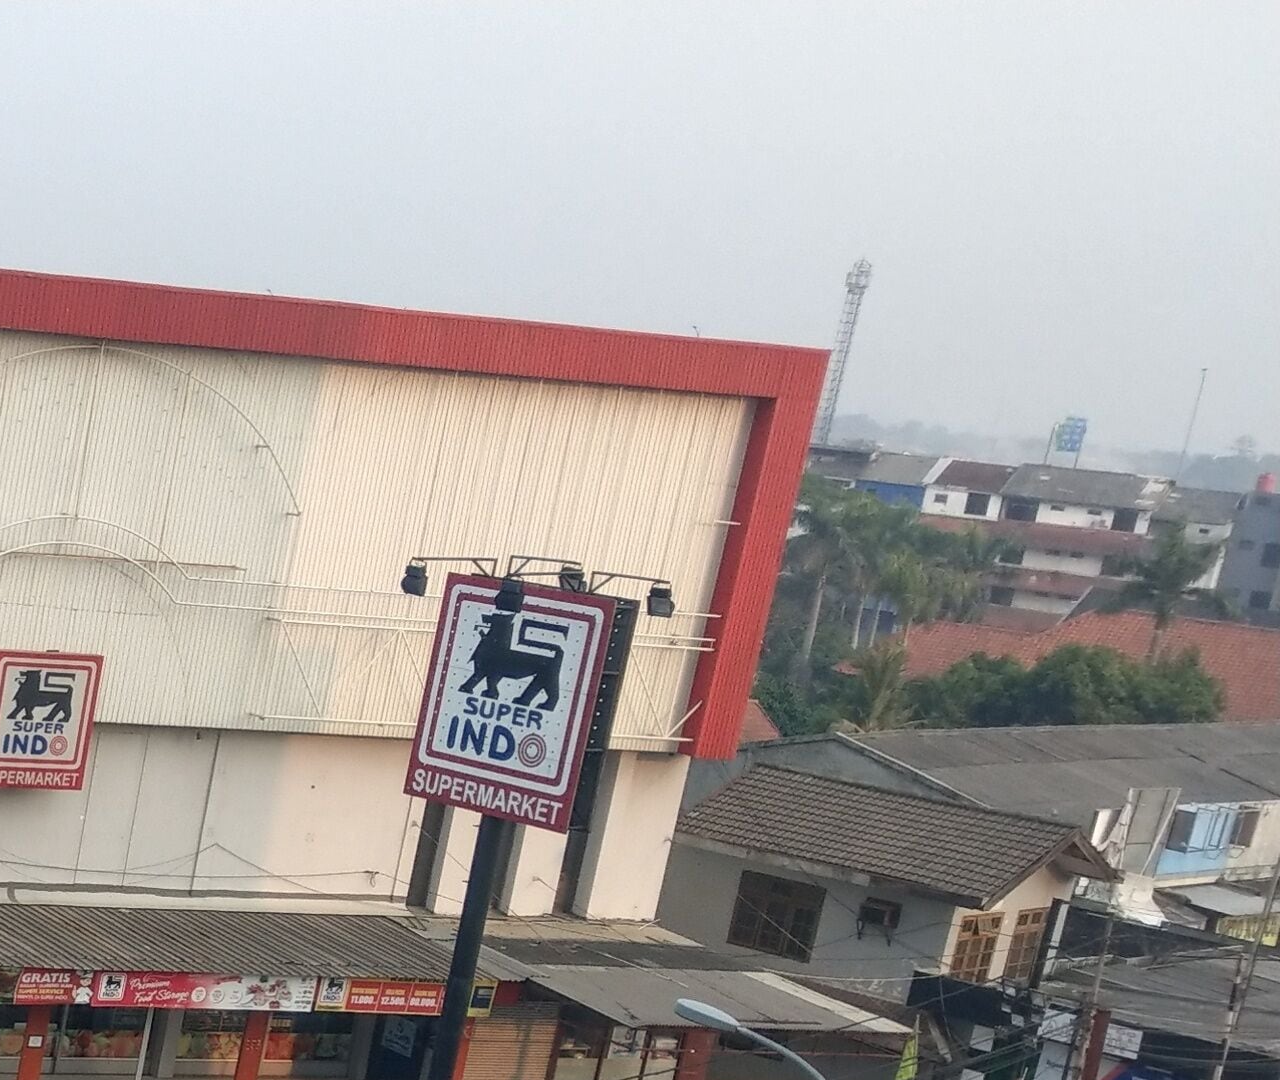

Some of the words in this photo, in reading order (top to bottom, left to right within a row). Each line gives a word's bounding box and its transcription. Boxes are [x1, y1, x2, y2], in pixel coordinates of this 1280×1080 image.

[12, 721, 64, 735] SUPER
[463, 697, 544, 731] SUPER
[2, 733, 68, 756] INDO
[446, 715, 547, 768] INDO
[412, 769, 563, 825] SUPERMARKET
[22, 973, 71, 983] GRATIS
